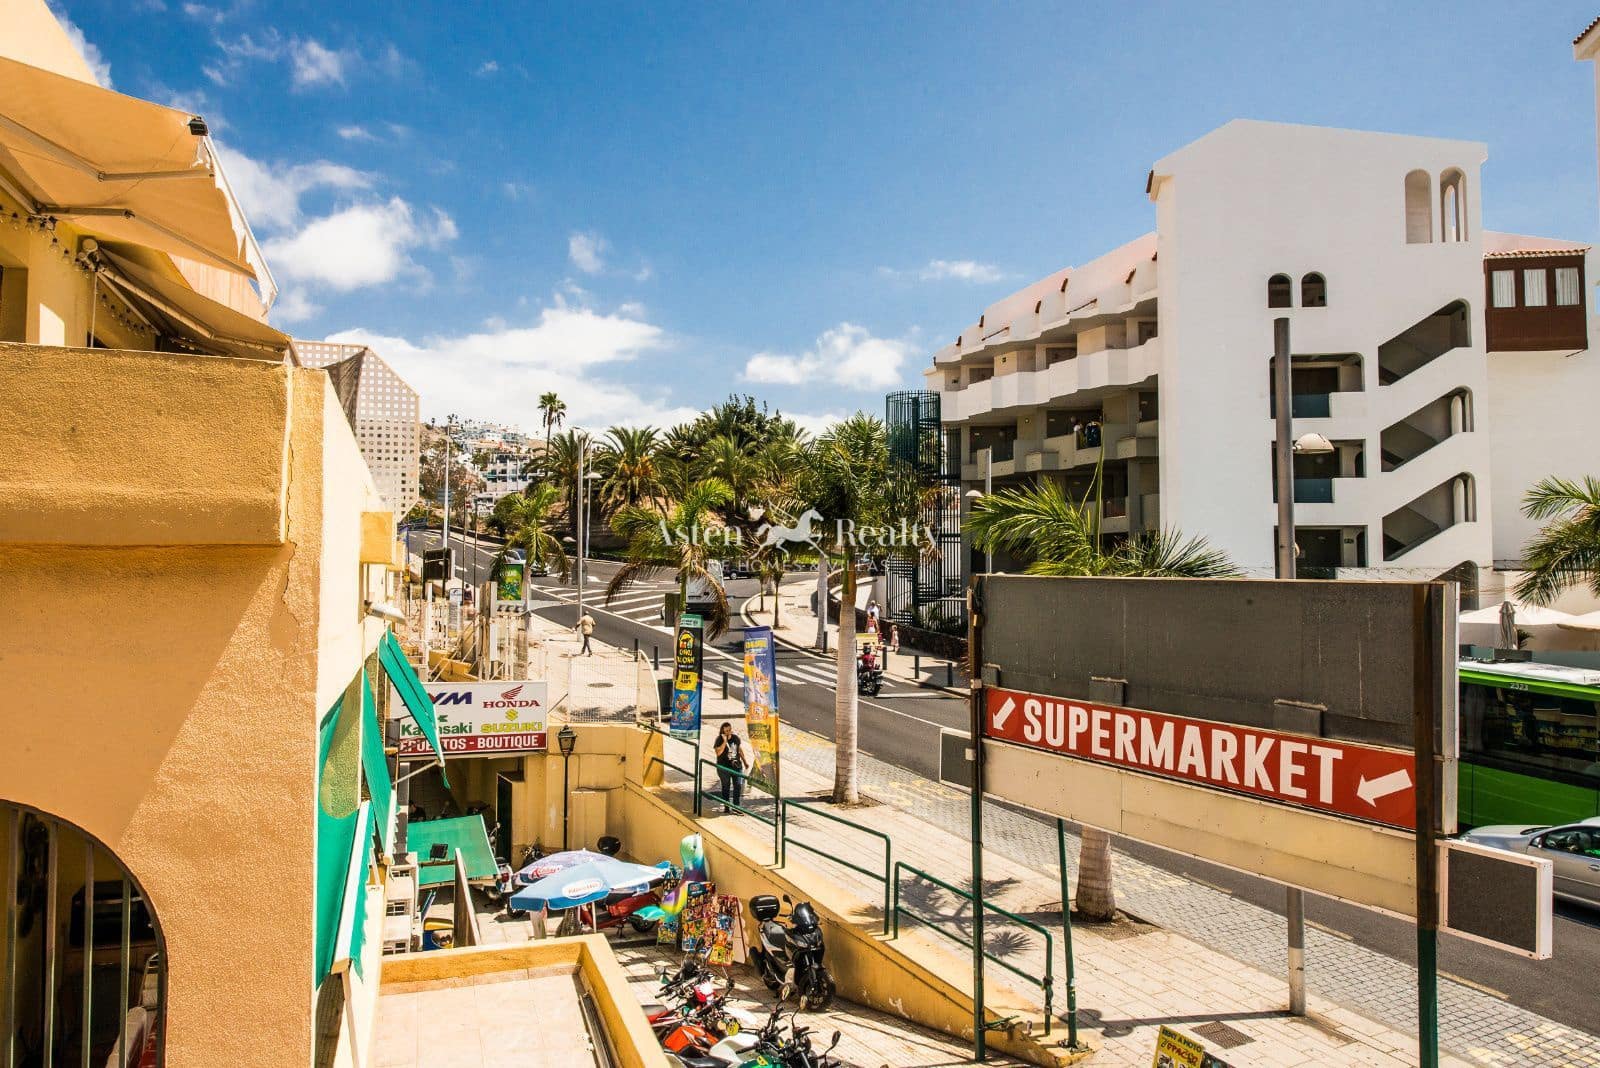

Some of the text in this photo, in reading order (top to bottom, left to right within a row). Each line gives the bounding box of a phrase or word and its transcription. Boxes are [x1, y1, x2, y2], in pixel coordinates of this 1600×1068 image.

[483, 700, 541, 709] HONDA
[401, 722, 472, 736] Kasaki
[481, 721, 543, 733] SUZUKI
[477, 735, 539, 749] BOUTIQUE
[1022, 698, 1343, 805] SUPERMARKET
